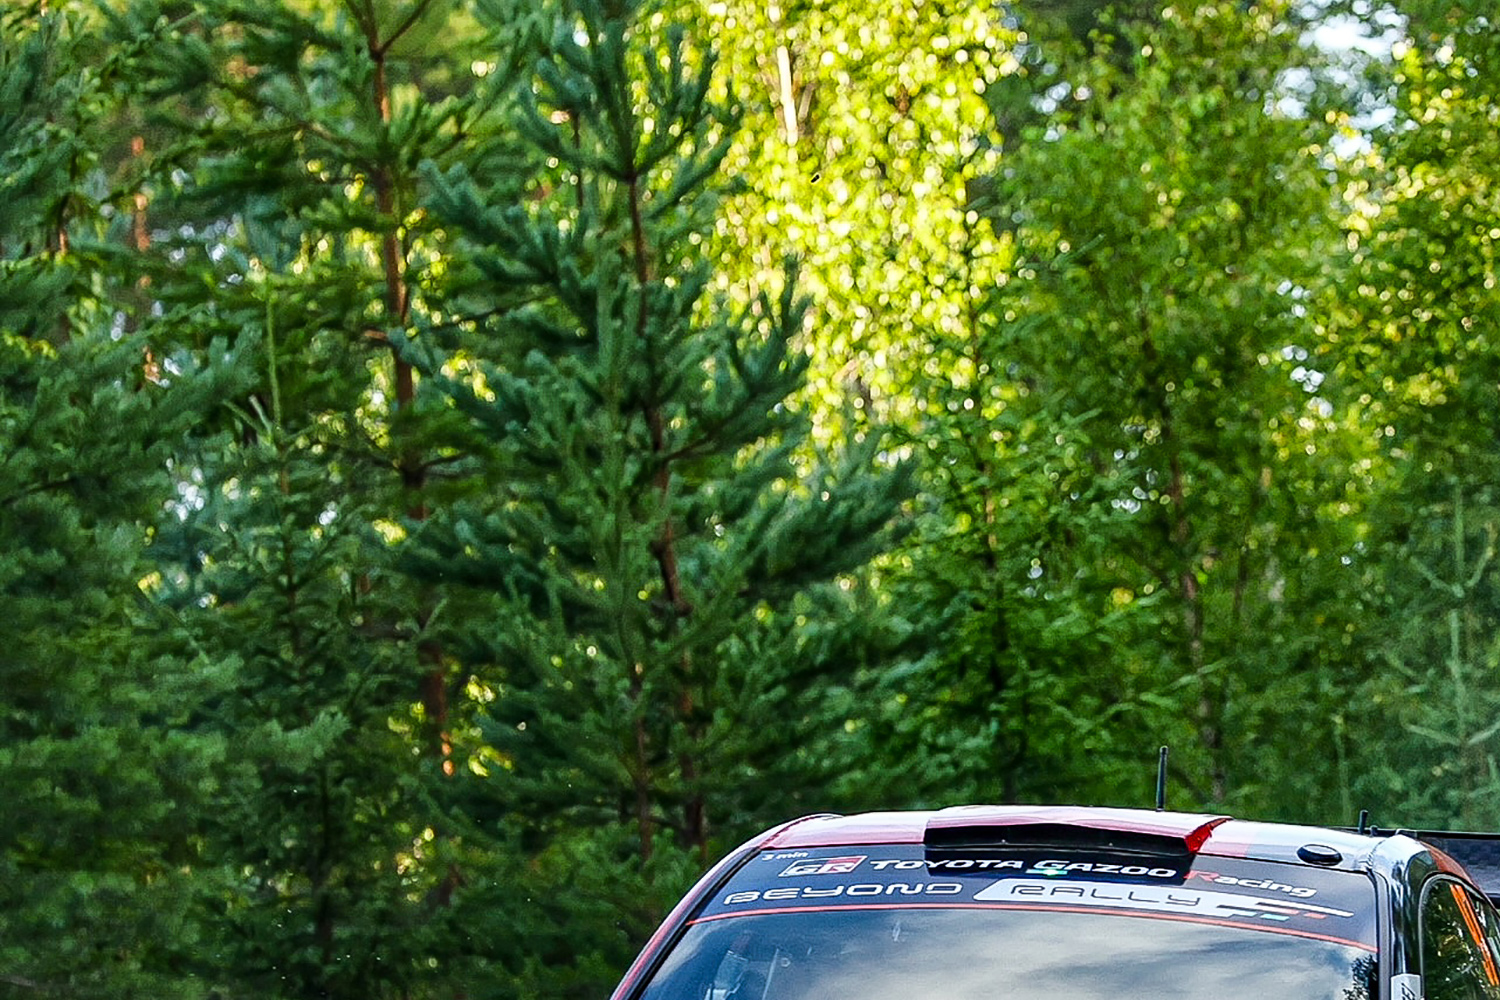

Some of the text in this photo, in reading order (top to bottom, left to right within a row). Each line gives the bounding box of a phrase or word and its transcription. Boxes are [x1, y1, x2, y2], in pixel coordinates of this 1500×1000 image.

[723, 882, 1201, 906] BEYOND RALLY
[869, 859, 1025, 871] TOYOTA
[1032, 859, 1178, 878] GAZOO
[1183, 869, 1319, 899] Racing
